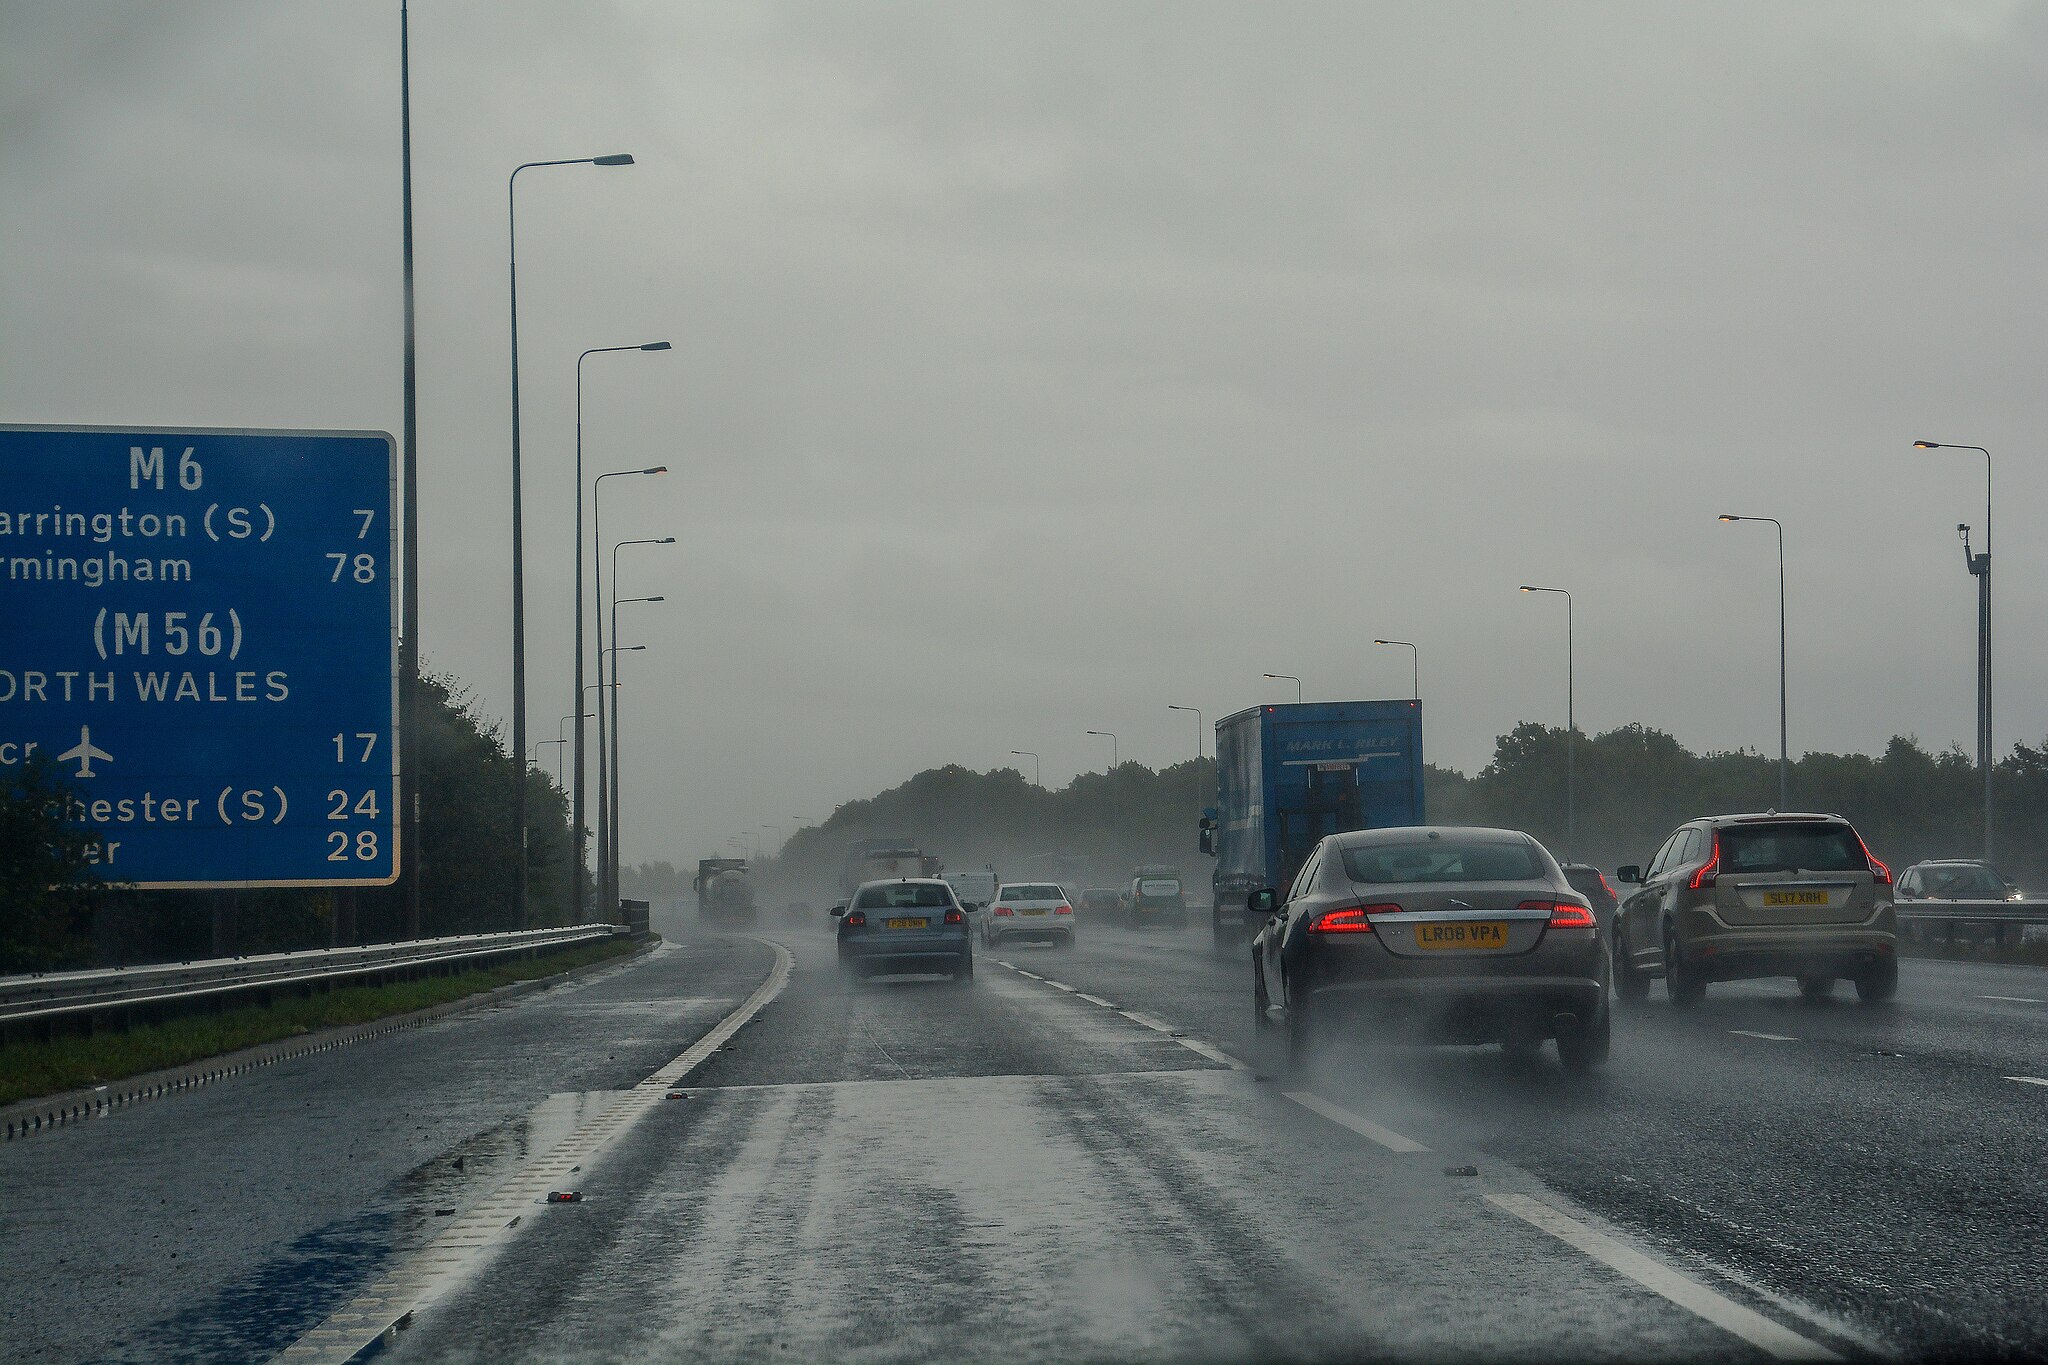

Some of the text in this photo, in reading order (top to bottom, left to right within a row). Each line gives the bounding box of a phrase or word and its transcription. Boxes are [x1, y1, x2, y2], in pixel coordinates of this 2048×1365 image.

[203, 502, 275, 542] (S)
[353, 509, 375, 539] 7
[325, 553, 375, 584] 78
[133, 671, 289, 702] WALES
[332, 732, 377, 763] 17
[1286, 740, 1332, 752] MARK
[217, 786, 288, 825] (S)
[327, 789, 380, 820] 24
[327, 830, 378, 861] 28
[1770, 891, 1822, 904] SL17 XRH
[1422, 925, 1500, 942] LR08 VPA
